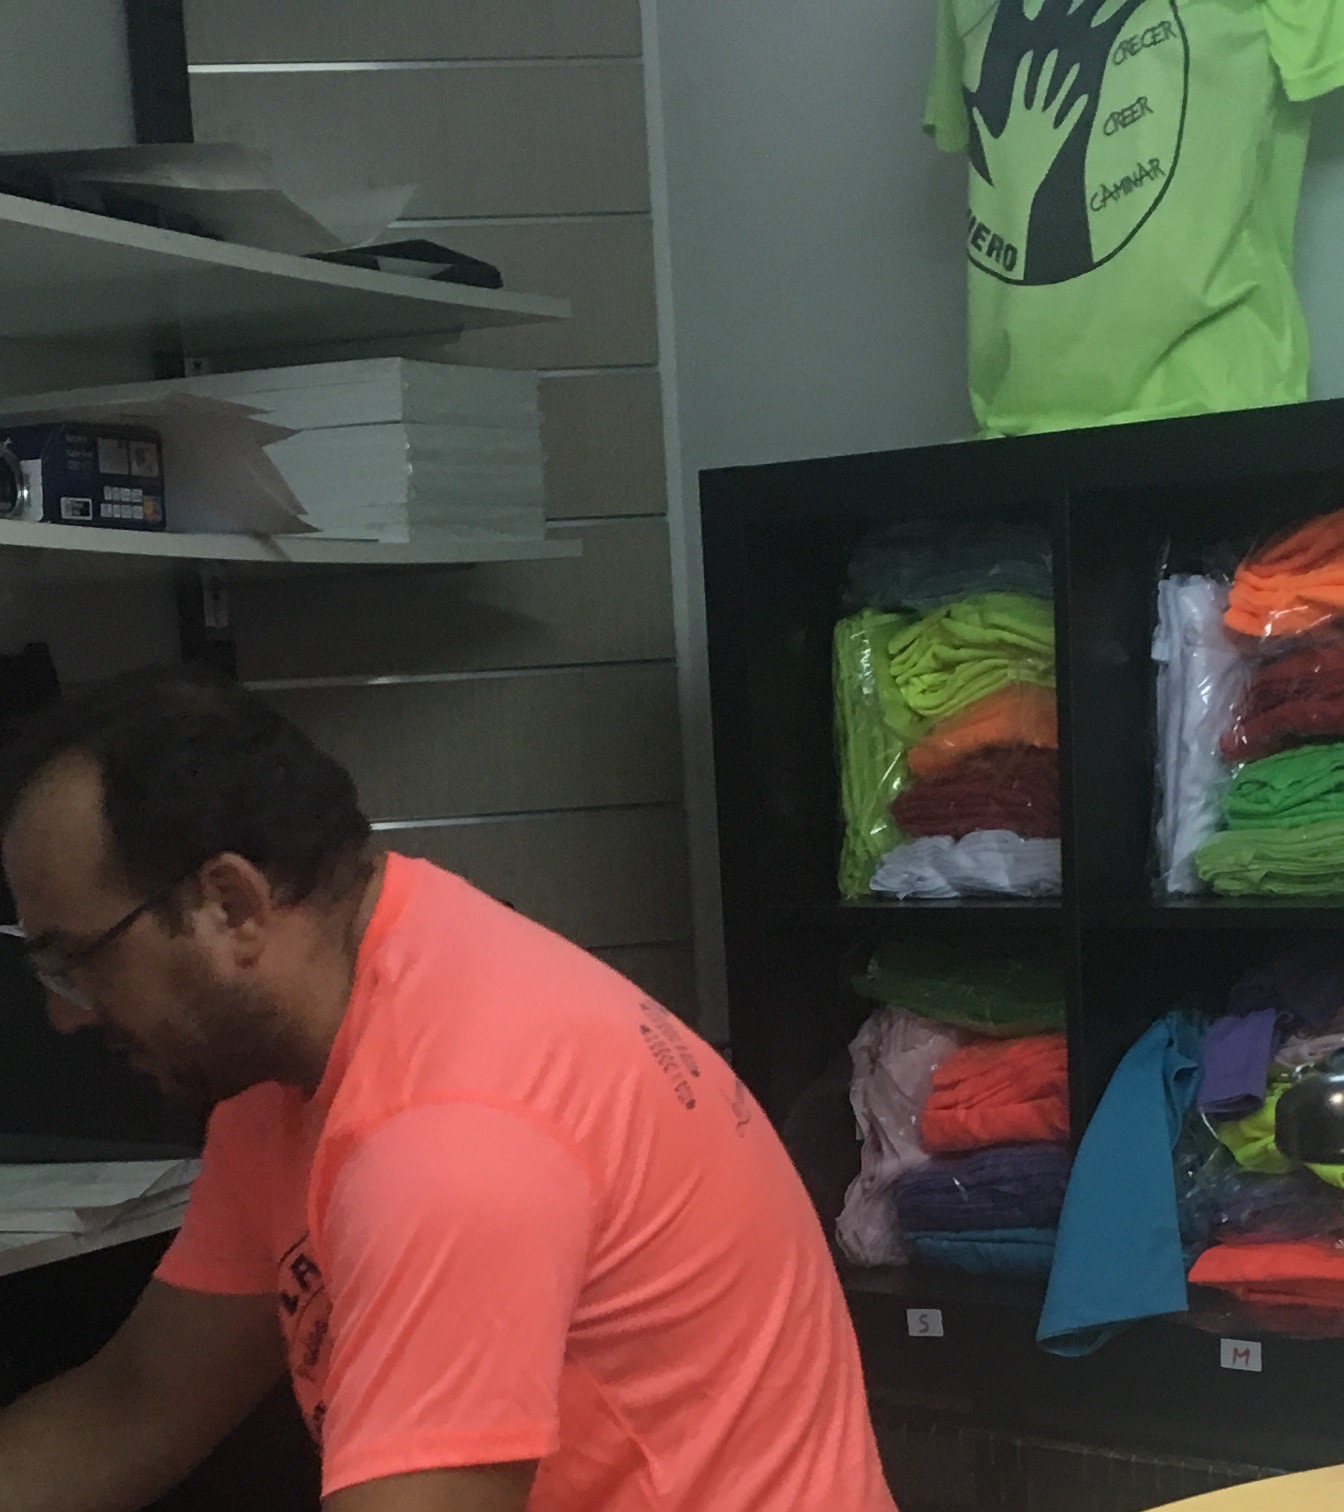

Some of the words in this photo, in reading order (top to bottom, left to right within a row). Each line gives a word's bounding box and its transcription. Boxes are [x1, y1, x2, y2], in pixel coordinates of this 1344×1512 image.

[1112, 20, 1178, 66] CRECER
[1103, 95, 1154, 138] CREER
[1089, 157, 1166, 213] CAMINAR
[967, 207, 1019, 272] IERO
[918, 1313, 930, 1333] S
[1231, 1346, 1251, 1366] M
